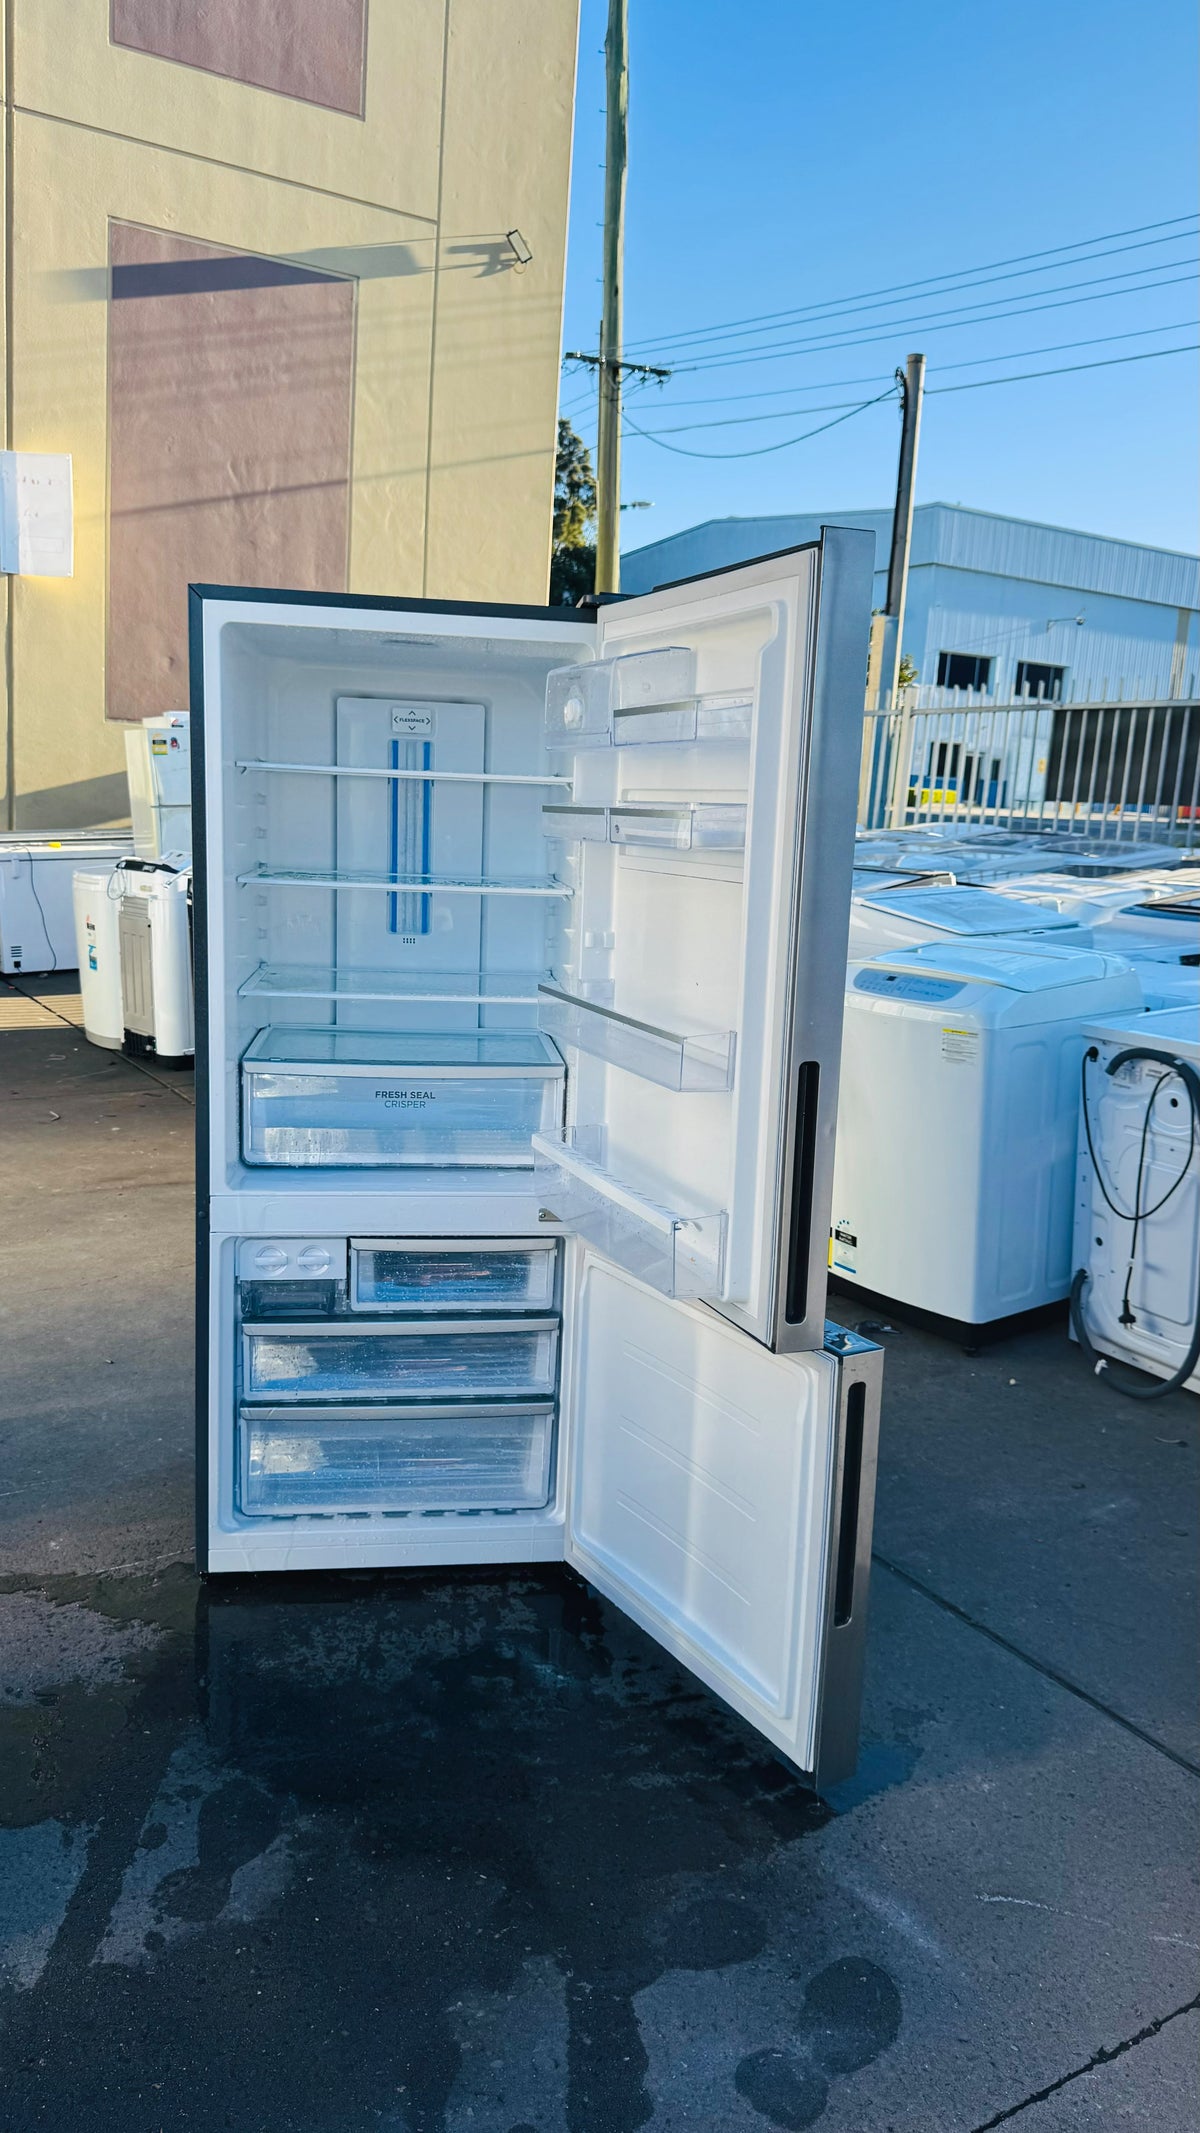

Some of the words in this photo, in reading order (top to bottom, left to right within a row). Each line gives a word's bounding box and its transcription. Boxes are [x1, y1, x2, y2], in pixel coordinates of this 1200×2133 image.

[375, 1090, 407, 1099] FRESH
[410, 1091, 436, 1100] SEAL
[384, 1100, 426, 1109] CRISPER
